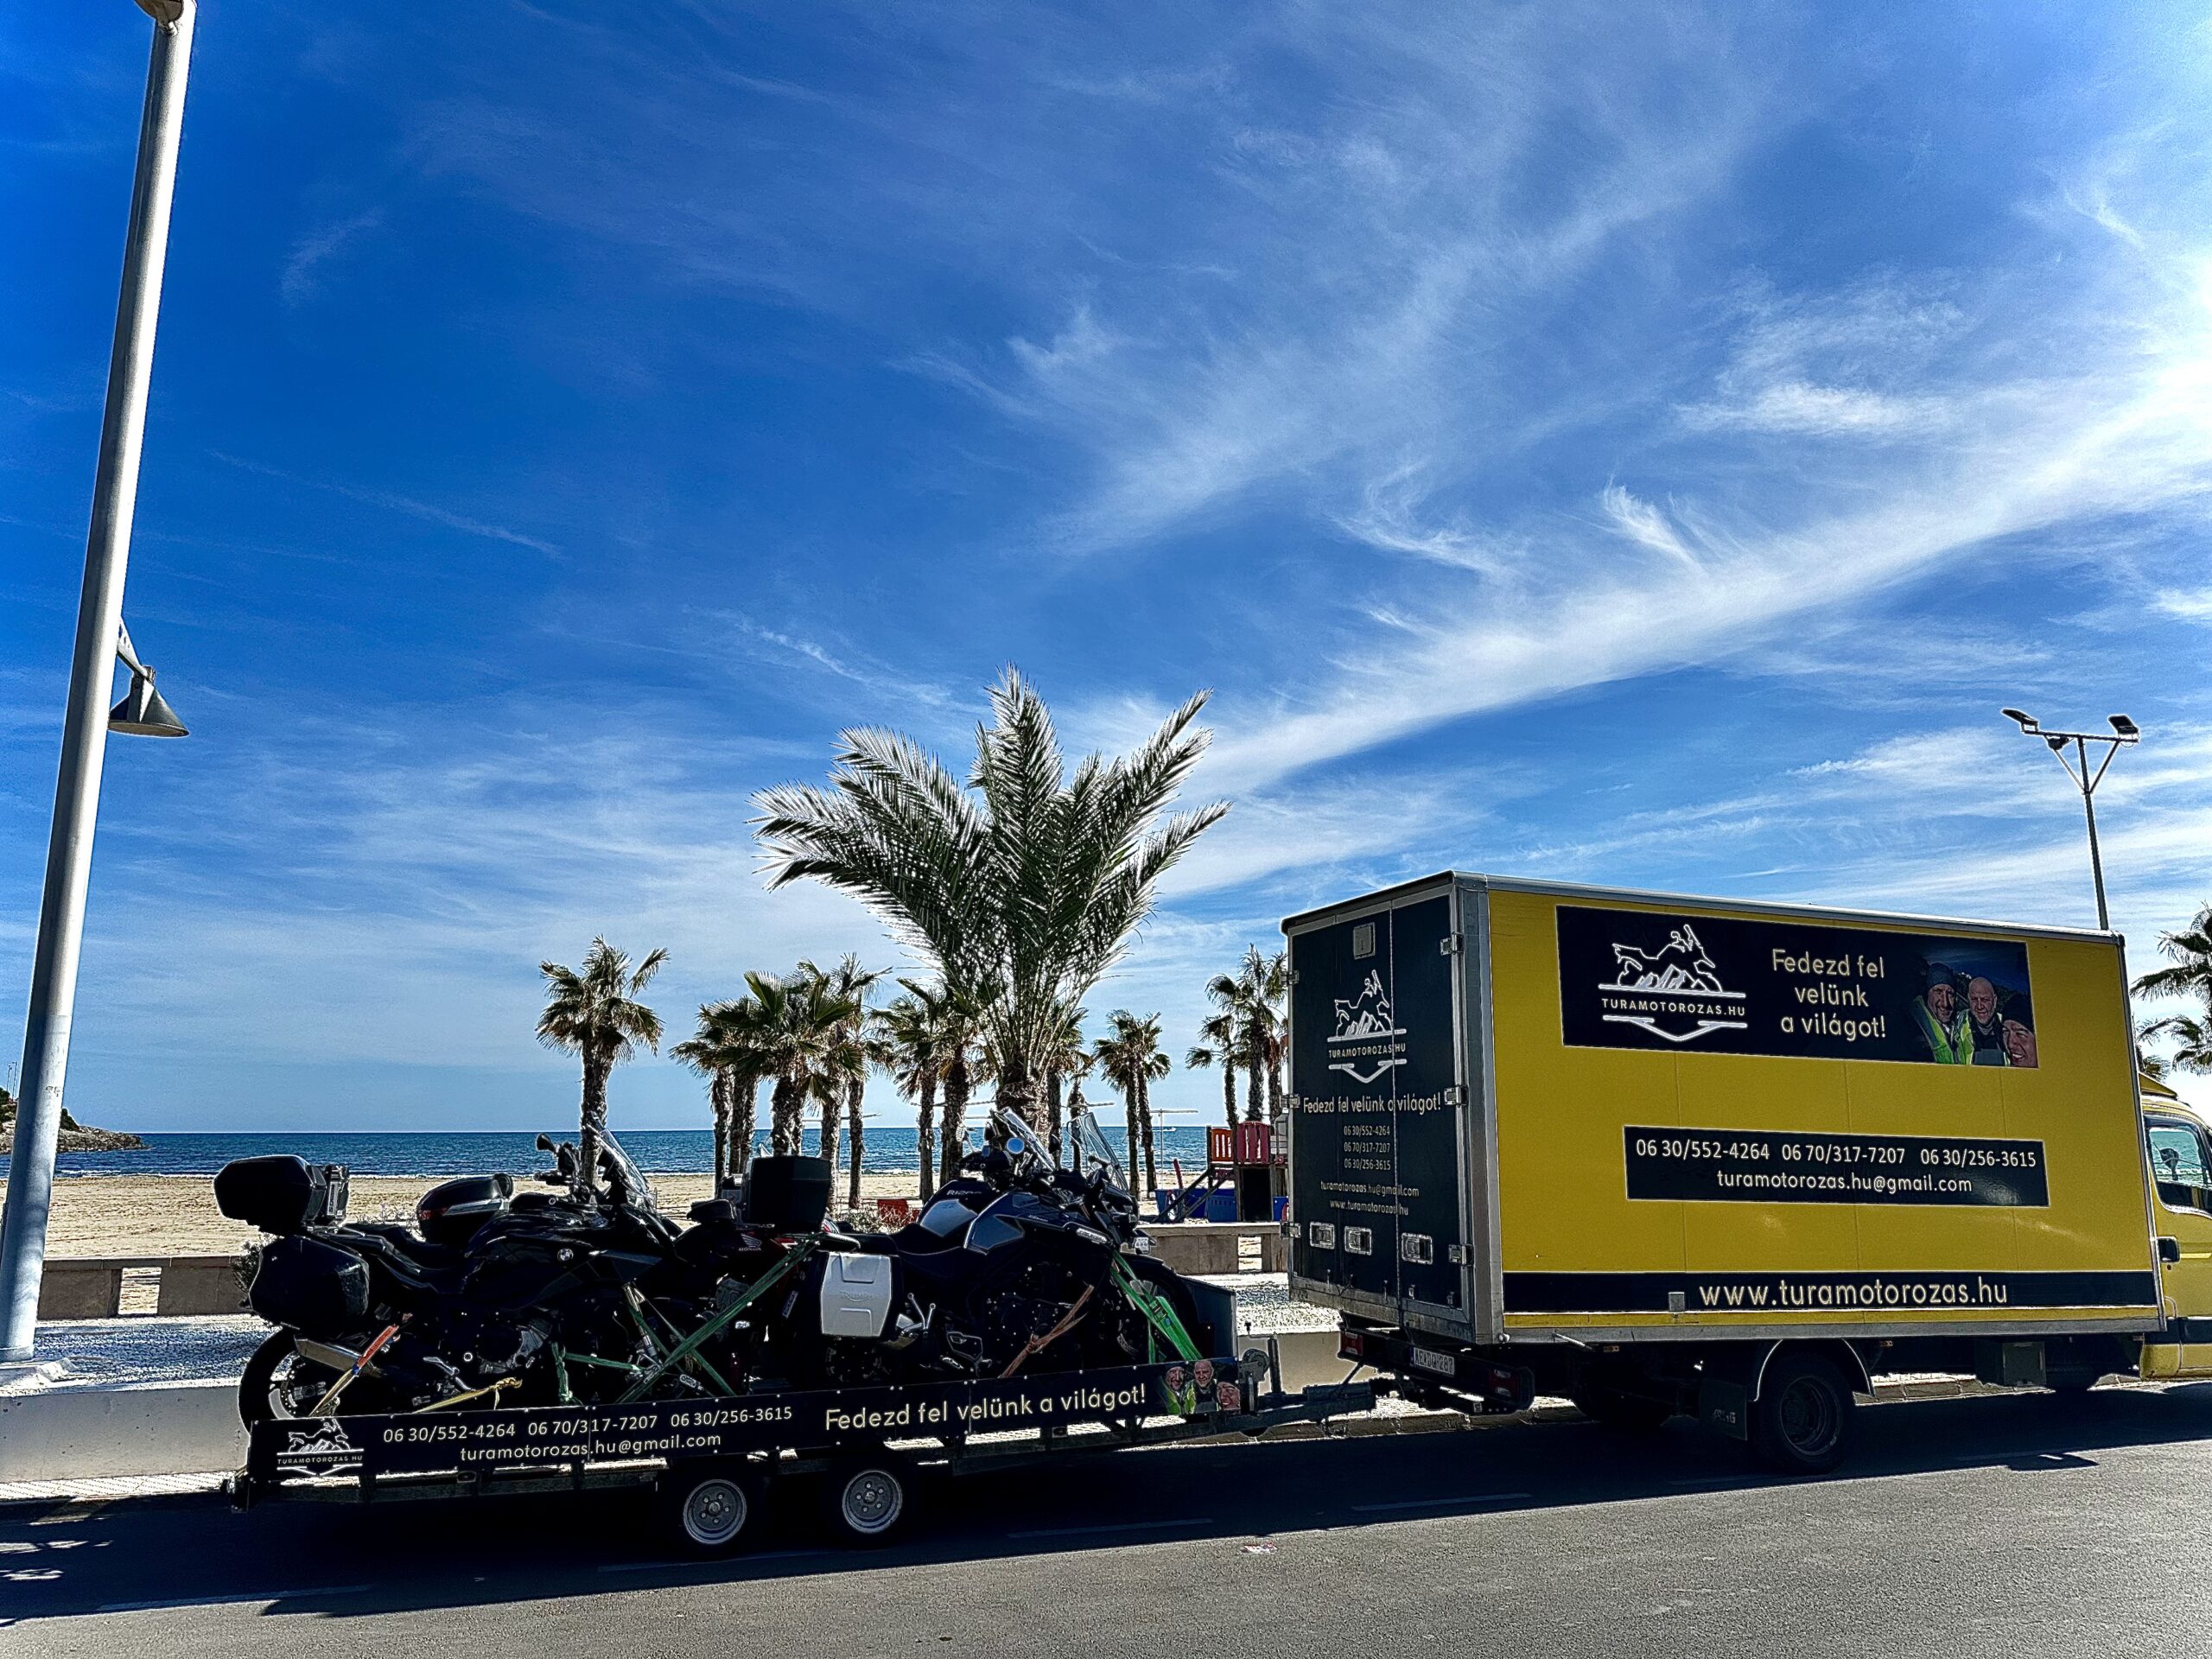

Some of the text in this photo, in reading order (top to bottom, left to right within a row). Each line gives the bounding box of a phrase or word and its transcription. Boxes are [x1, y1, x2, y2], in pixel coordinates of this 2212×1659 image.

[1772, 948, 1886, 979] Fedezd fel
[1601, 998, 1745, 1016] TURAMOTOROZAS.HU
[1794, 982, 1869, 1007] velünk
[1781, 1012, 1886, 1042] a világot!
[1328, 1042, 1407, 1058] TURAMOTOROZASHU
[1303, 1096, 1335, 1114] Fedezd
[1338, 1096, 1349, 1113] fel
[1351, 1095, 1385, 1113] velünk
[1396, 1091, 1441, 1116] világot!
[1636, 1139, 2037, 1168] 06 30/552-4264 06 70/317-7207 06 30/256-3615
[1717, 1170, 1972, 1195] turamotorozas.hu@gmail.com
[1329, 1199, 1409, 1216] www.turamotorozashu
[1699, 1275, 2008, 1306] www.turamotorozas.hu
[825, 1382, 1146, 1431] Fedezd fel velünk a világot!
[383, 1406, 792, 1443] 06 30/552-4264 06 70/317-7207 06 30/256-3615
[276, 1455, 363, 1464] TURAMOTOROZASHU
[460, 1433, 721, 1462] turamotorozas.hu@gmail.com
